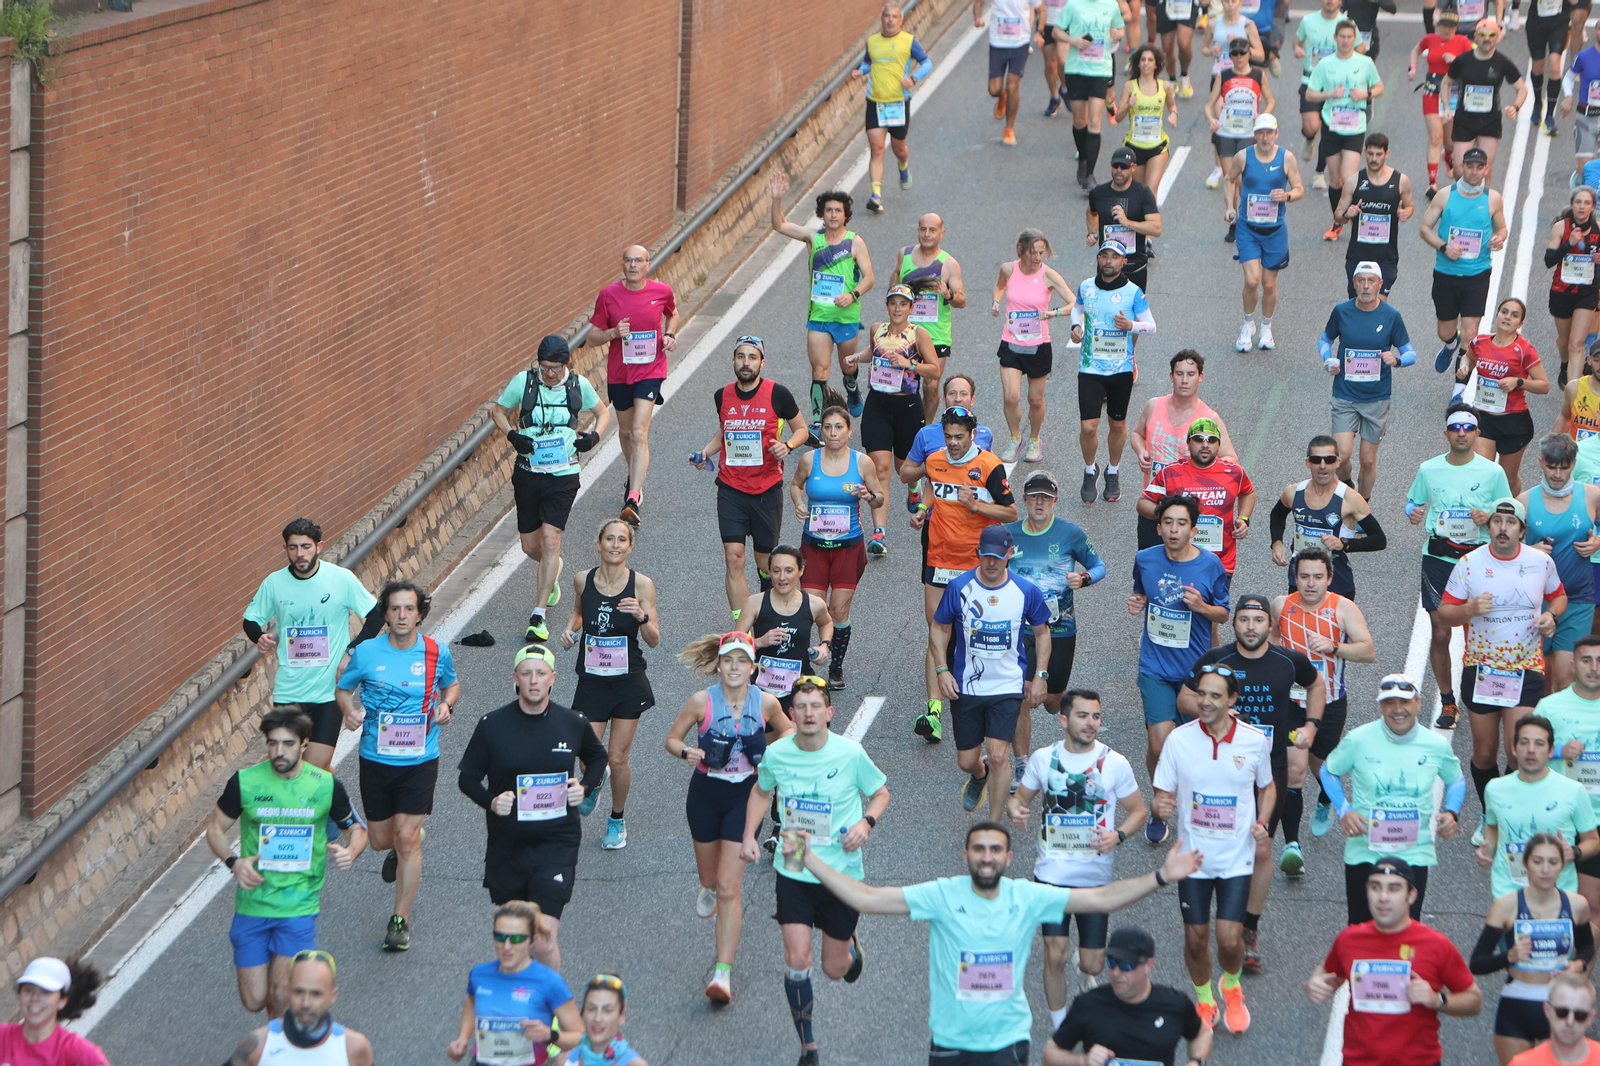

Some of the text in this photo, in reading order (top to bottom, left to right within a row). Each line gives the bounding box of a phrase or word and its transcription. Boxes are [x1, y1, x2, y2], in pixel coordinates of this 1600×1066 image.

[1361, 202, 1392, 210] CAPACITY
[1461, 230, 1480, 238] ZURICH
[1162, 611, 1185, 620] ZURICH
[984, 622, 1007, 630] ZURICH
[1235, 705, 1275, 713] WORLD
[536, 777, 562, 785] ZURICH
[536, 792, 552, 800] 8223
[1205, 798, 1232, 806] ZURICH
[257, 807, 280, 817] MEDIO
[799, 804, 826, 812] ZURICH
[1387, 812, 1415, 820] ZURICH
[798, 816, 816, 826] 10265
[978, 955, 1008, 963] ZURICH
